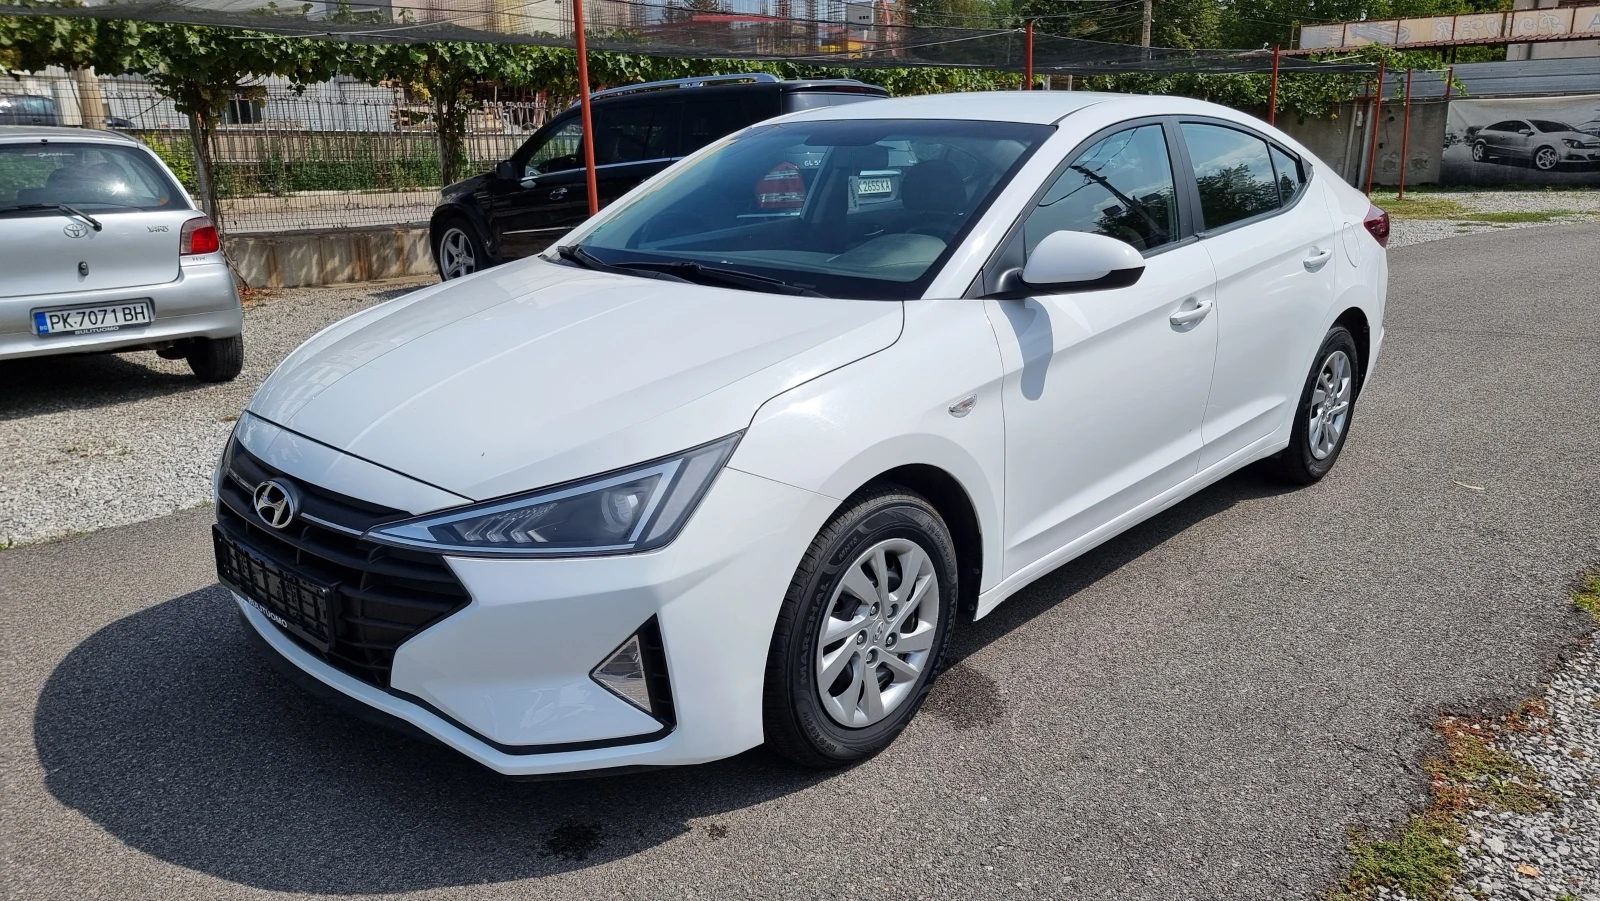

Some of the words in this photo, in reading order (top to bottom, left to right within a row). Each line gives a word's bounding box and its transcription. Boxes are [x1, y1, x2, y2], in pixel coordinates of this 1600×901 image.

[864, 180, 880, 192] 2655
[881, 180, 890, 191] KA
[76, 308, 119, 327] 7071
[122, 305, 146, 322] BH
[74, 326, 120, 335] BULITUOMO
[247, 596, 288, 628] BULITUOMO
[799, 581, 829, 685] MARSHAL
